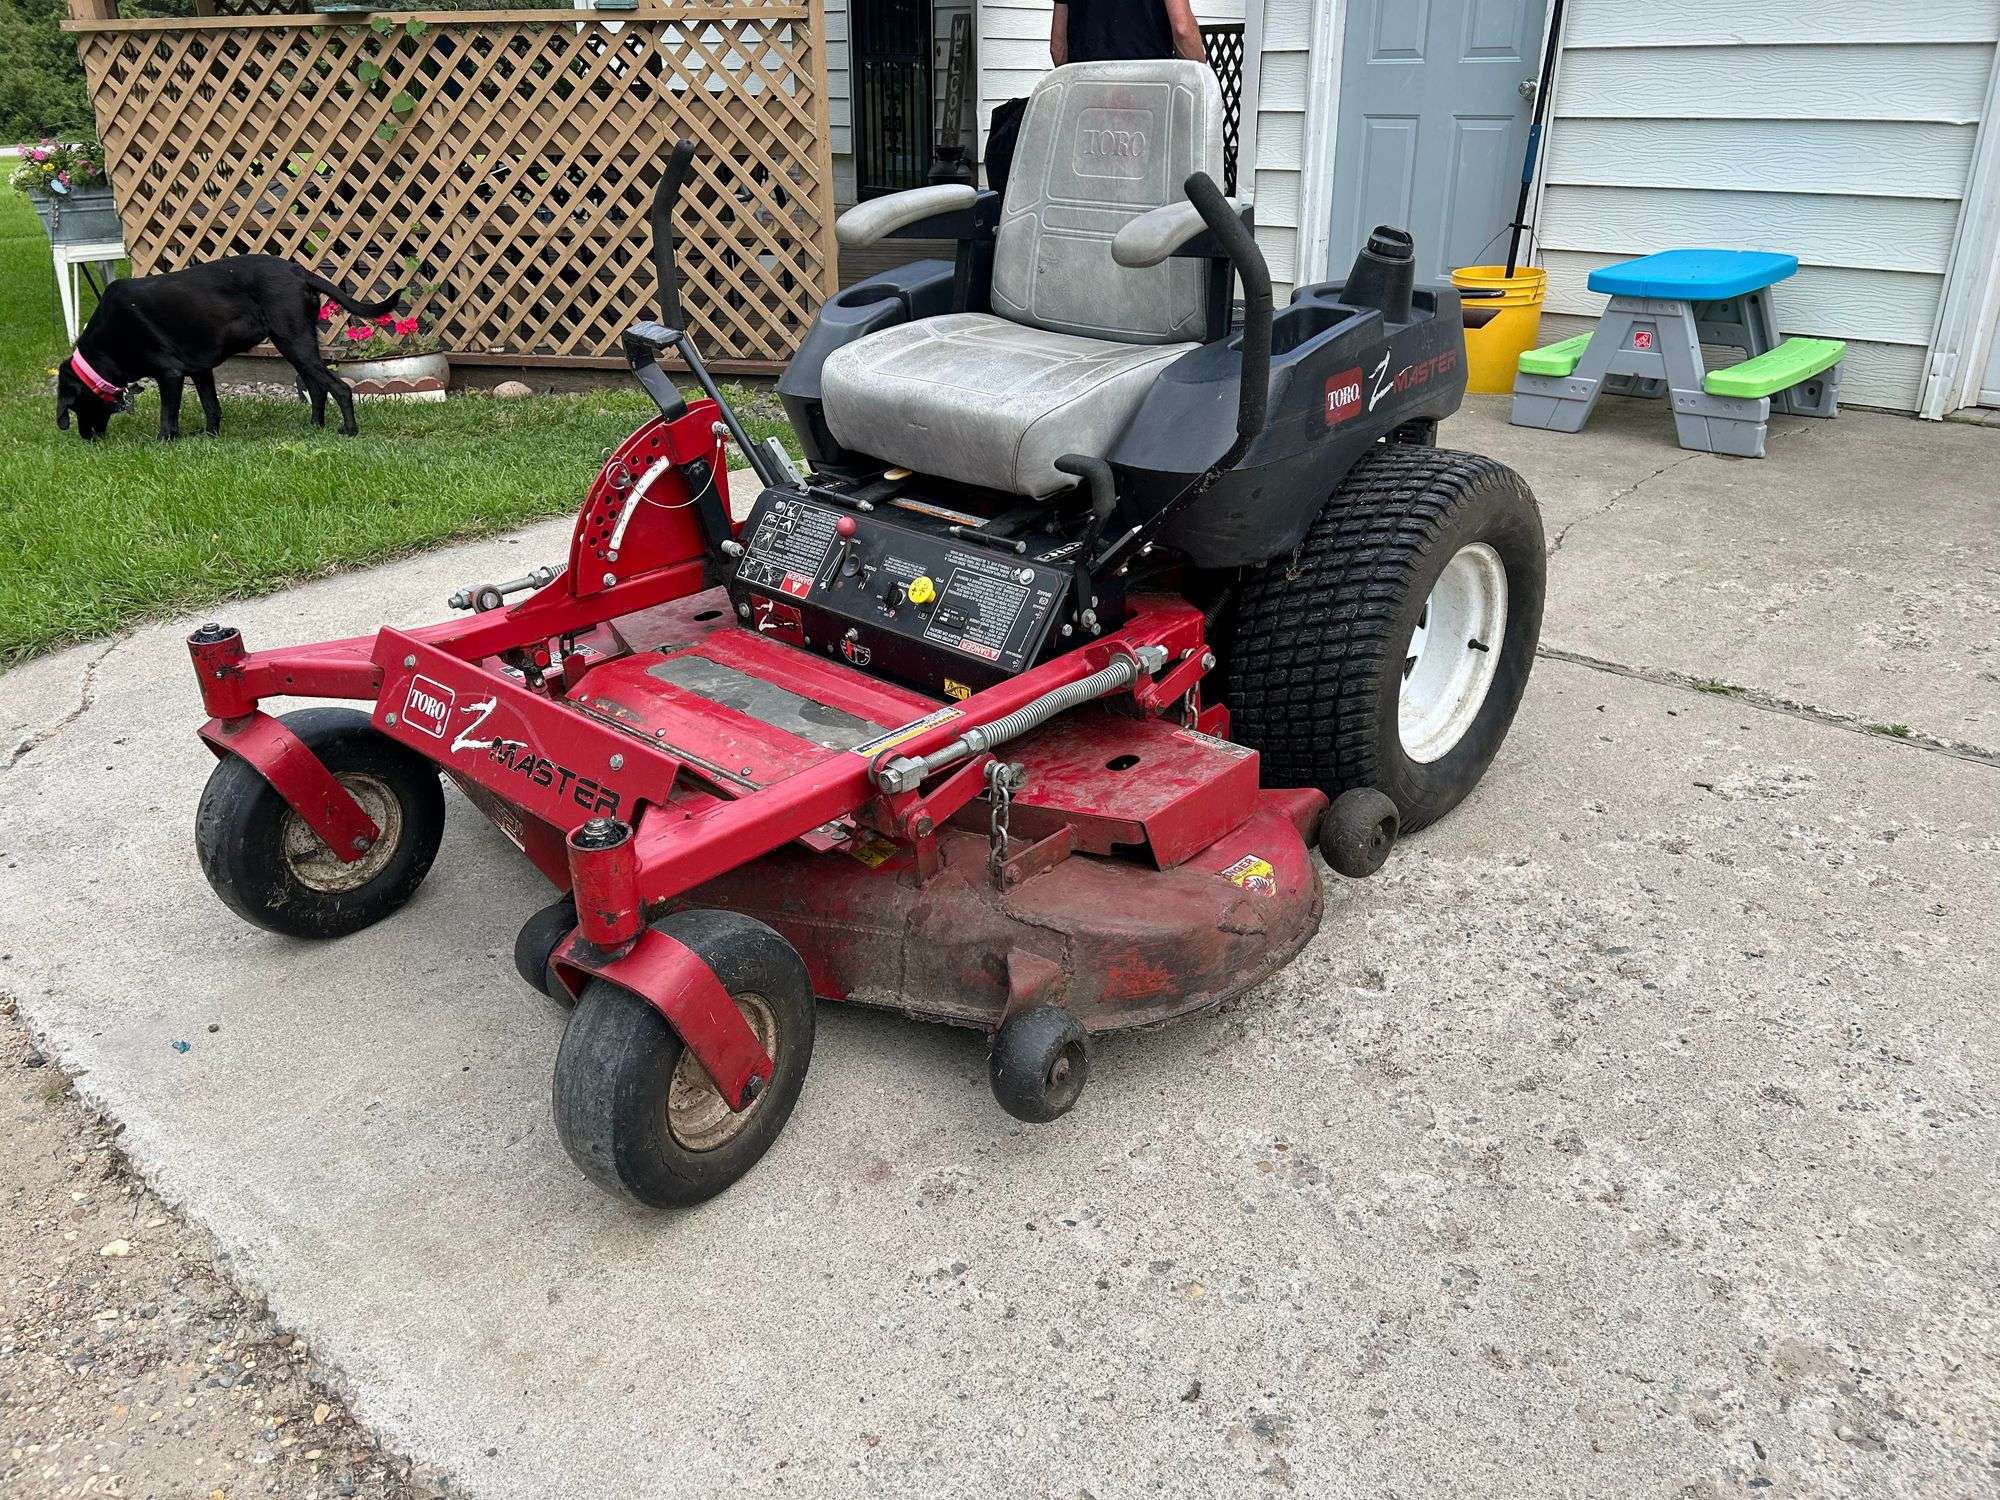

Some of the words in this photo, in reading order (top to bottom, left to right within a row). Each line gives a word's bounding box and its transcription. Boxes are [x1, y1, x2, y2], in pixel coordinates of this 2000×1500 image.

[947, 19, 965, 134] WELCOM
[1082, 129, 1146, 157] TORO
[1393, 348, 1457, 393] MASTER
[1327, 383, 1360, 411] TORO
[786, 571, 813, 585] DANGER
[409, 689, 446, 720] TORO
[488, 736, 621, 817] MASTER
